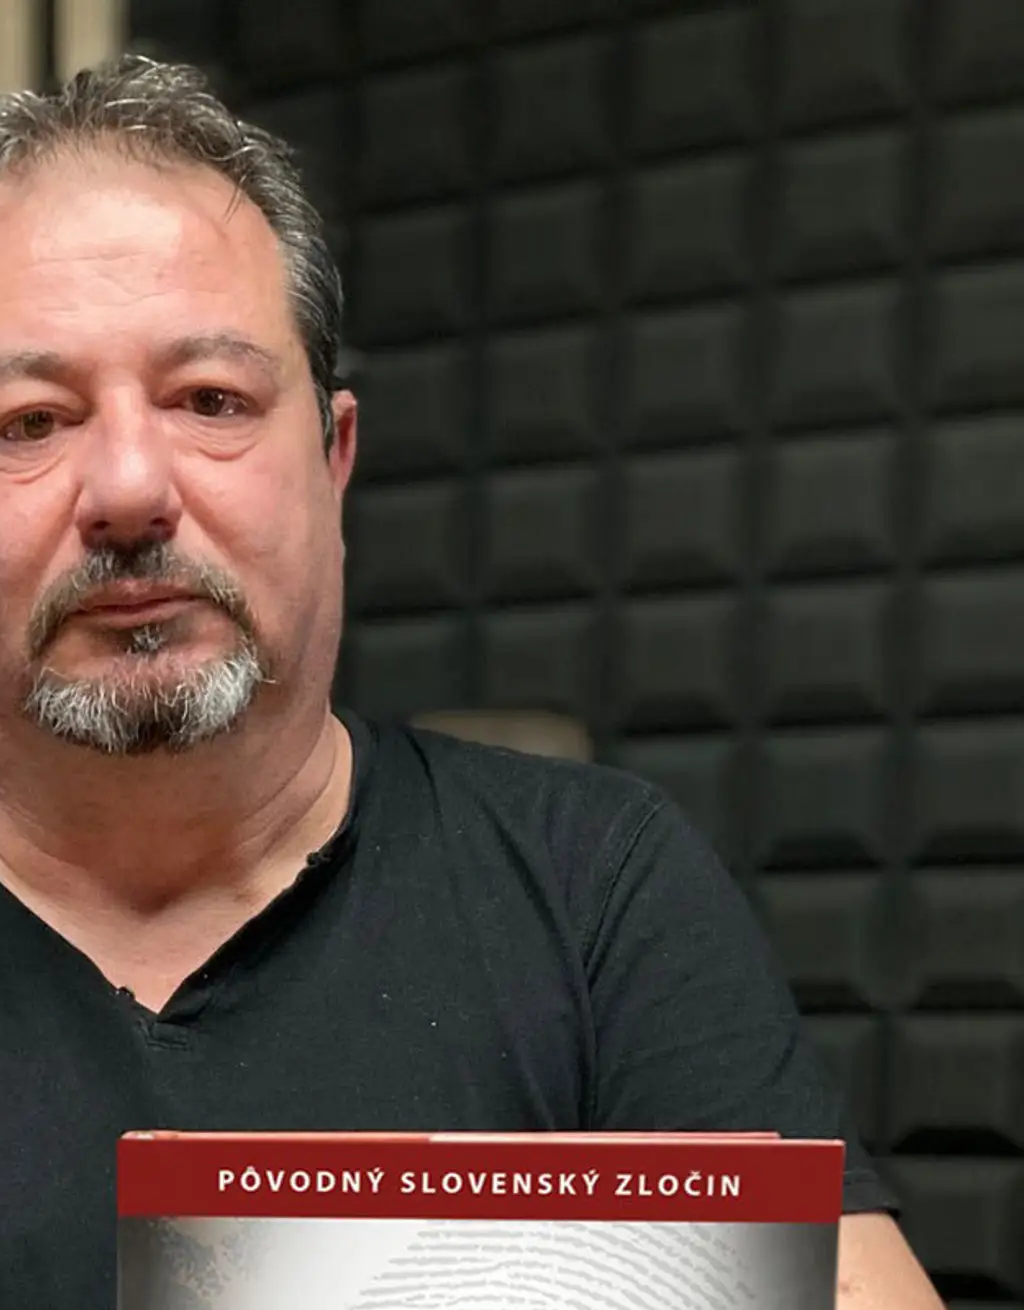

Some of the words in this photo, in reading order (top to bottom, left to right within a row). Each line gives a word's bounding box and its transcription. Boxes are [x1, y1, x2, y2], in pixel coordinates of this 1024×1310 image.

[218, 1164, 387, 1194] PÔVODNÝ
[400, 1167, 600, 1196] SLOVENSKÝ
[615, 1170, 743, 1197] ZLOČIN
